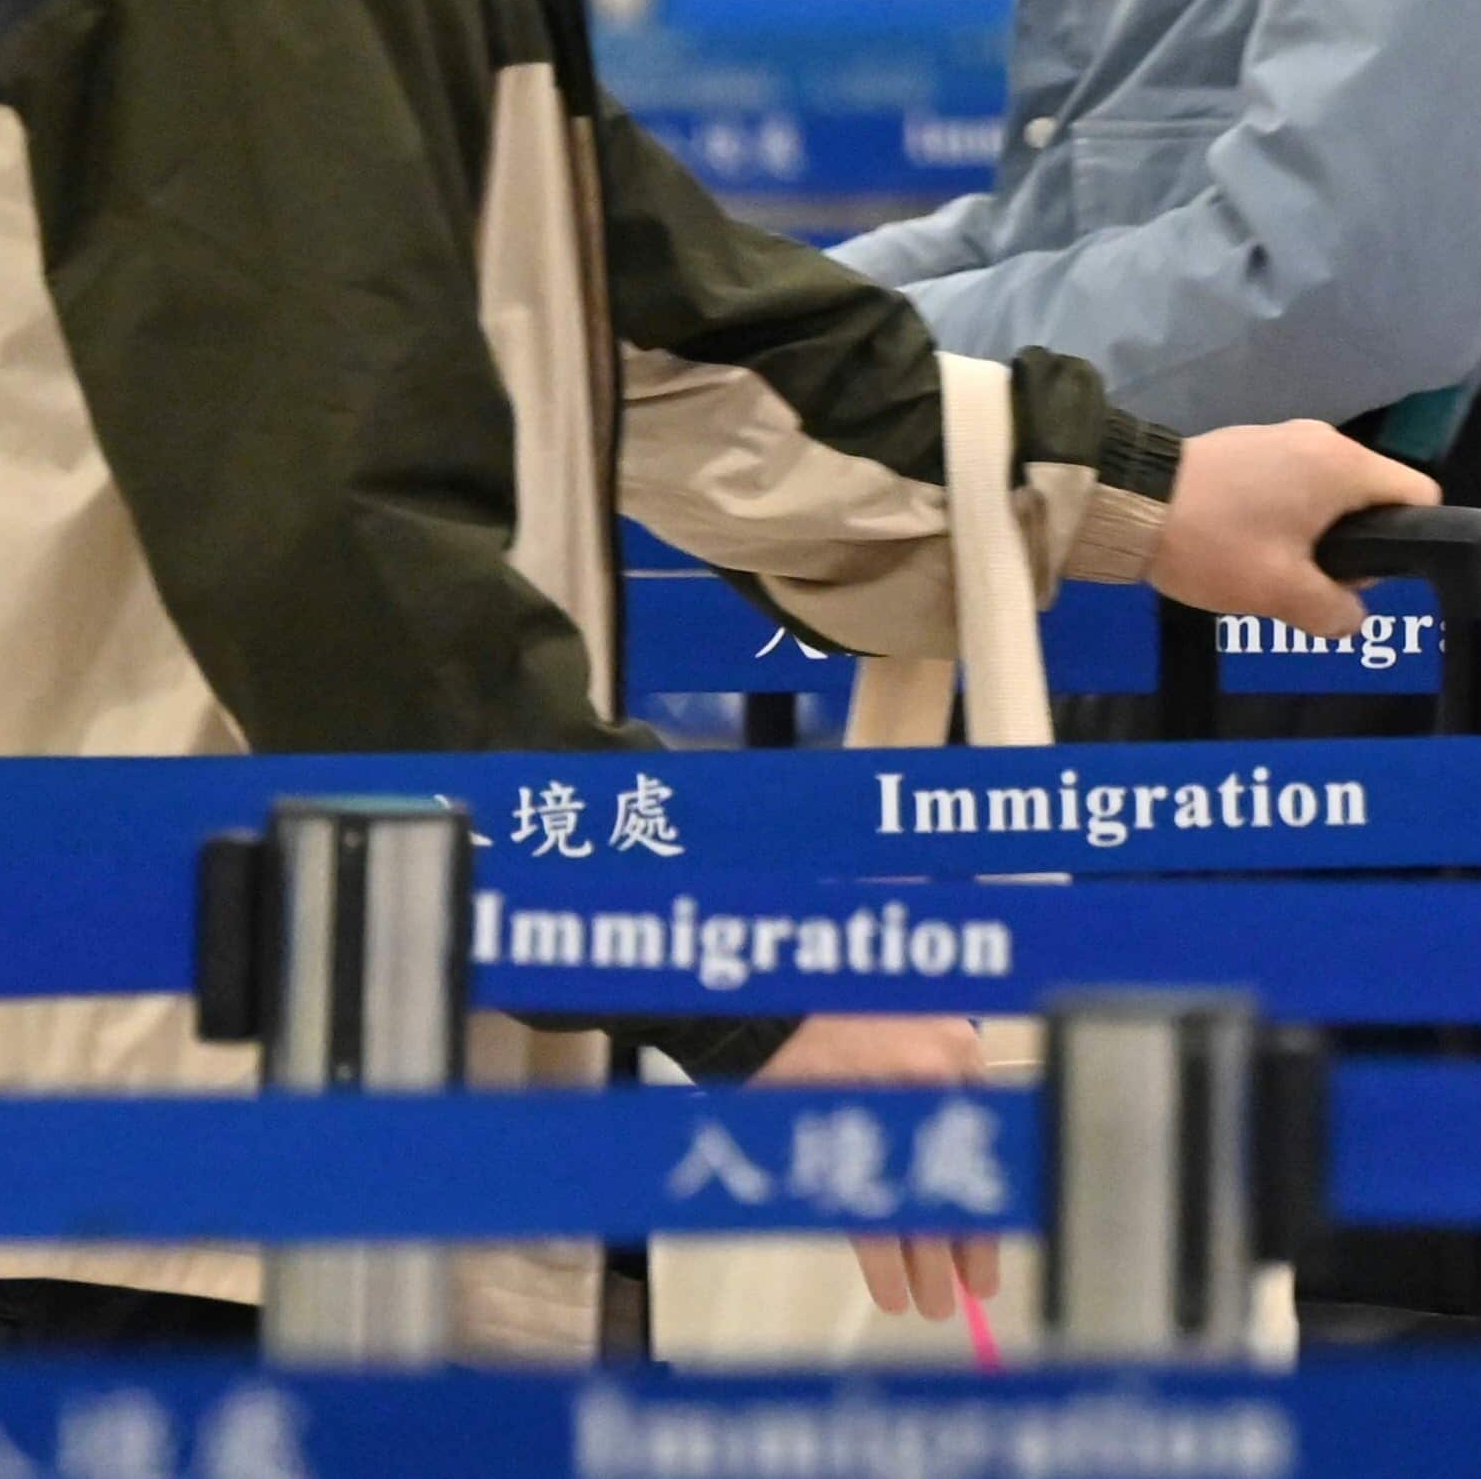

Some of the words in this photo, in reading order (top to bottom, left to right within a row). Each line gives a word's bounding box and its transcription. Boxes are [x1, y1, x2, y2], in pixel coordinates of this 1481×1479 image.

[433, 772, 685, 858] 境處
[876, 766, 1367, 848] Immigration
[472, 891, 1011, 989] Immigration
